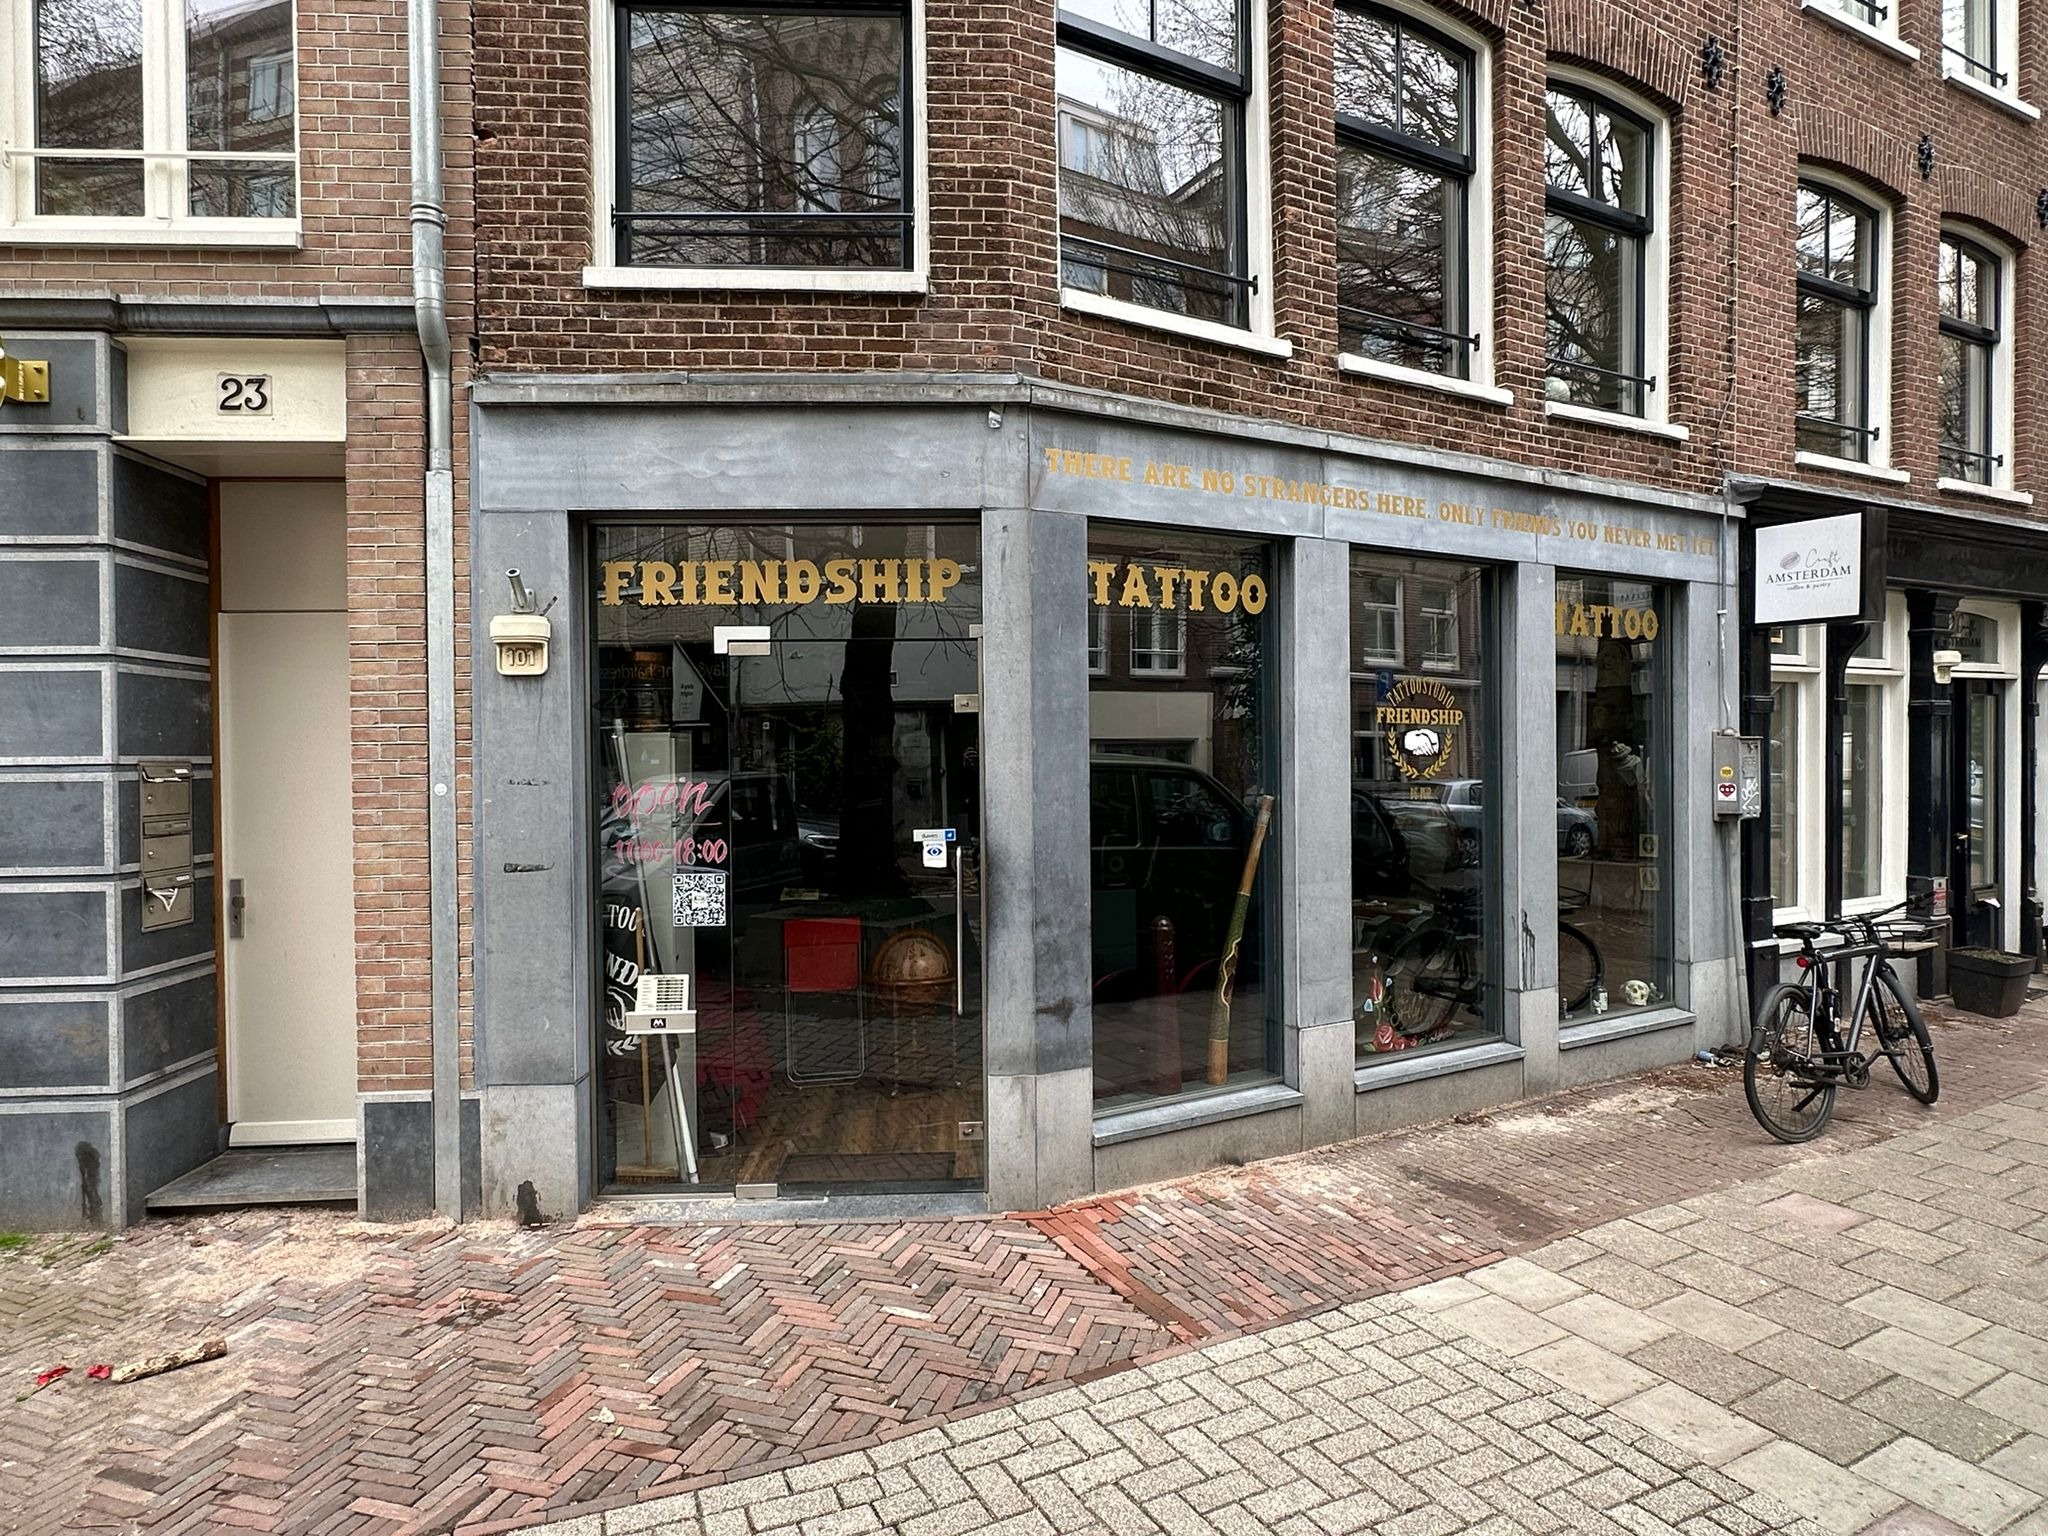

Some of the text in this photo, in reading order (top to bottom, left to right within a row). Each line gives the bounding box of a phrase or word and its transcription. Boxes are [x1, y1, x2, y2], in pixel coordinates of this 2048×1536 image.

[219, 377, 268, 412] 23
[1045, 447, 1133, 482] THERE
[1144, 461, 1192, 489] ARE
[1202, 468, 1235, 494] NO
[1243, 473, 1370, 512] STRANGERS
[1439, 502, 1485, 527] ONLY
[1492, 508, 1561, 537] FRIENDS
[1567, 519, 1598, 541] YOU
[1604, 525, 1651, 547] NEVER
[601, 558, 962, 606] FRIENDSHIP
[1088, 560, 1268, 615] TATTOO
[1766, 565, 1851, 584] AMSTERDAM
[504, 649, 536, 668] 101
[1386, 678, 1456, 709] TATTOOSTUDIO
[1376, 706, 1463, 726] FRIENDSHIP
[612, 781, 715, 828] open
